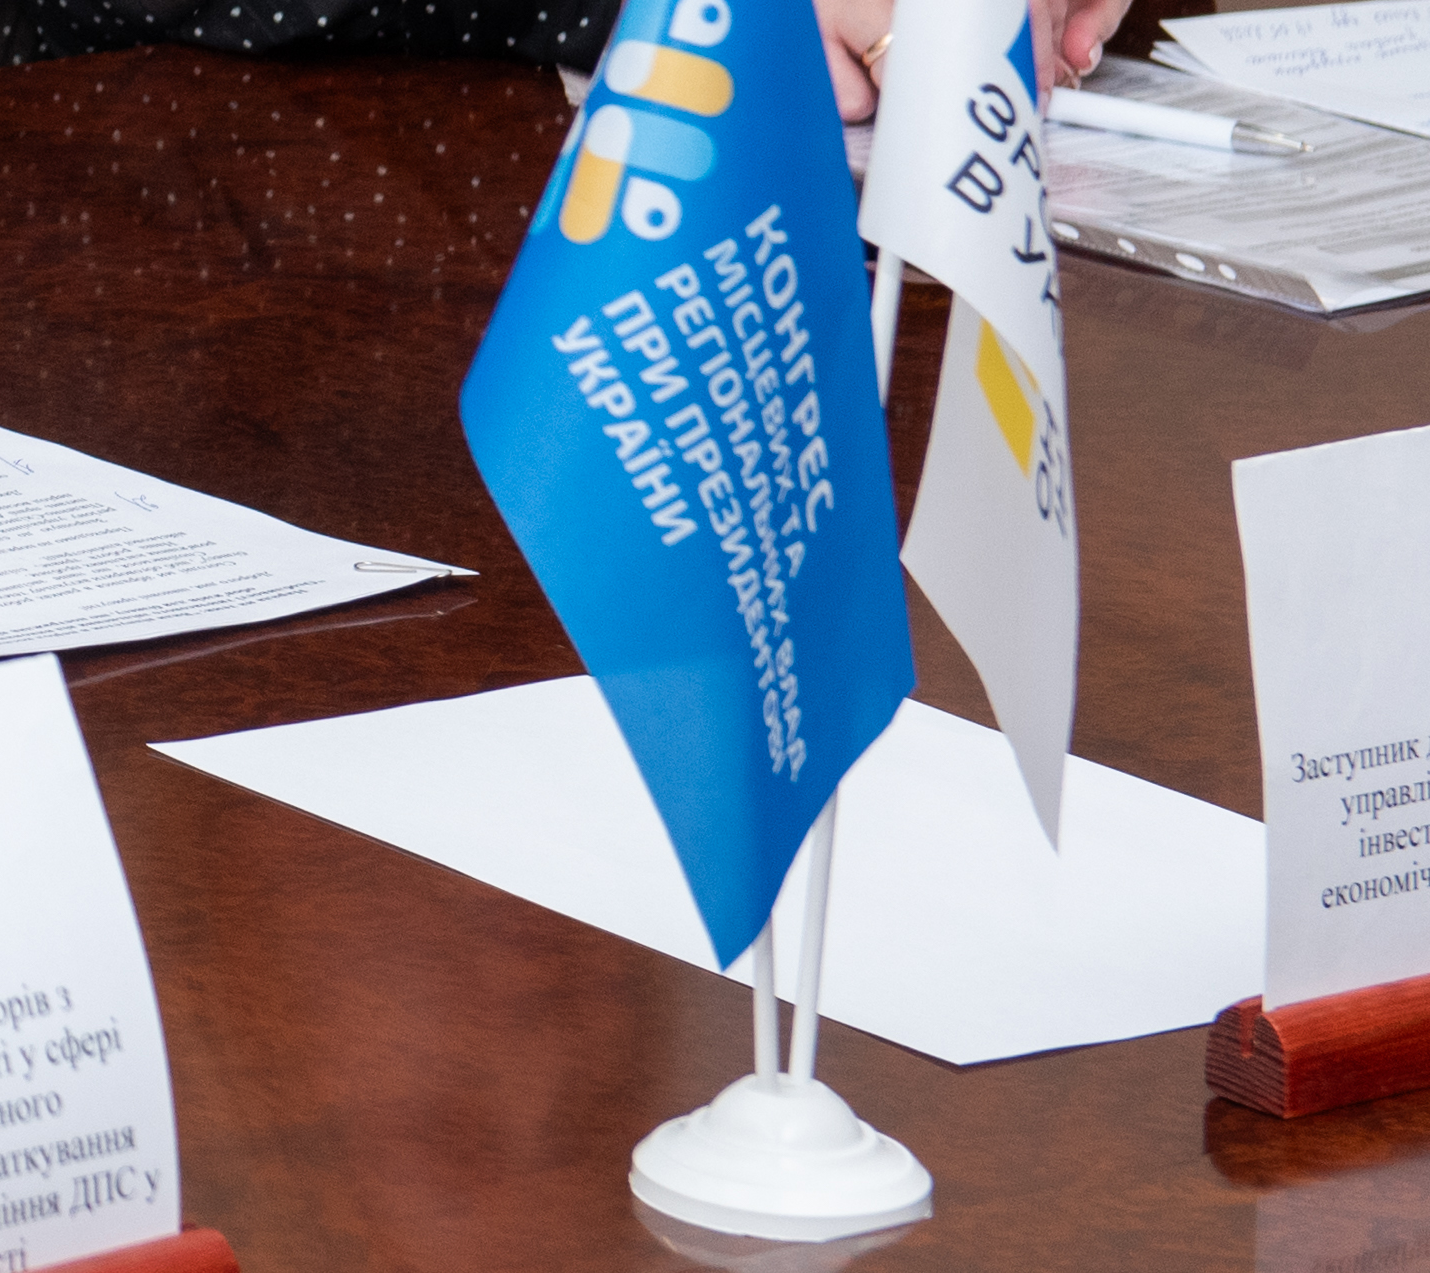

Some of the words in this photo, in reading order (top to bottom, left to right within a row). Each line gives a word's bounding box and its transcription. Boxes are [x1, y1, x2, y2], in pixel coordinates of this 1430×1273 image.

[552, 315, 698, 547] УКРАЇНИ
[654, 263, 790, 637] РЕГІОНАЛЬНИХ
[703, 238, 795, 503] МІСЦЕВИХ
[781, 503, 806, 578] ТА
[745, 204, 834, 532] КОНГРЕС
[602, 290, 689, 404] ПРИ
[665, 404, 785, 774] ПРЕЗИДЕНТОВІ
[1291, 738, 1420, 783] Заступник
[19, 1043, 36, 1082] у
[45, 1016, 123, 1071] сфері
[56, 985, 74, 1012] з
[69, 1165, 137, 1218] ДПС
[144, 1168, 161, 1204] у
